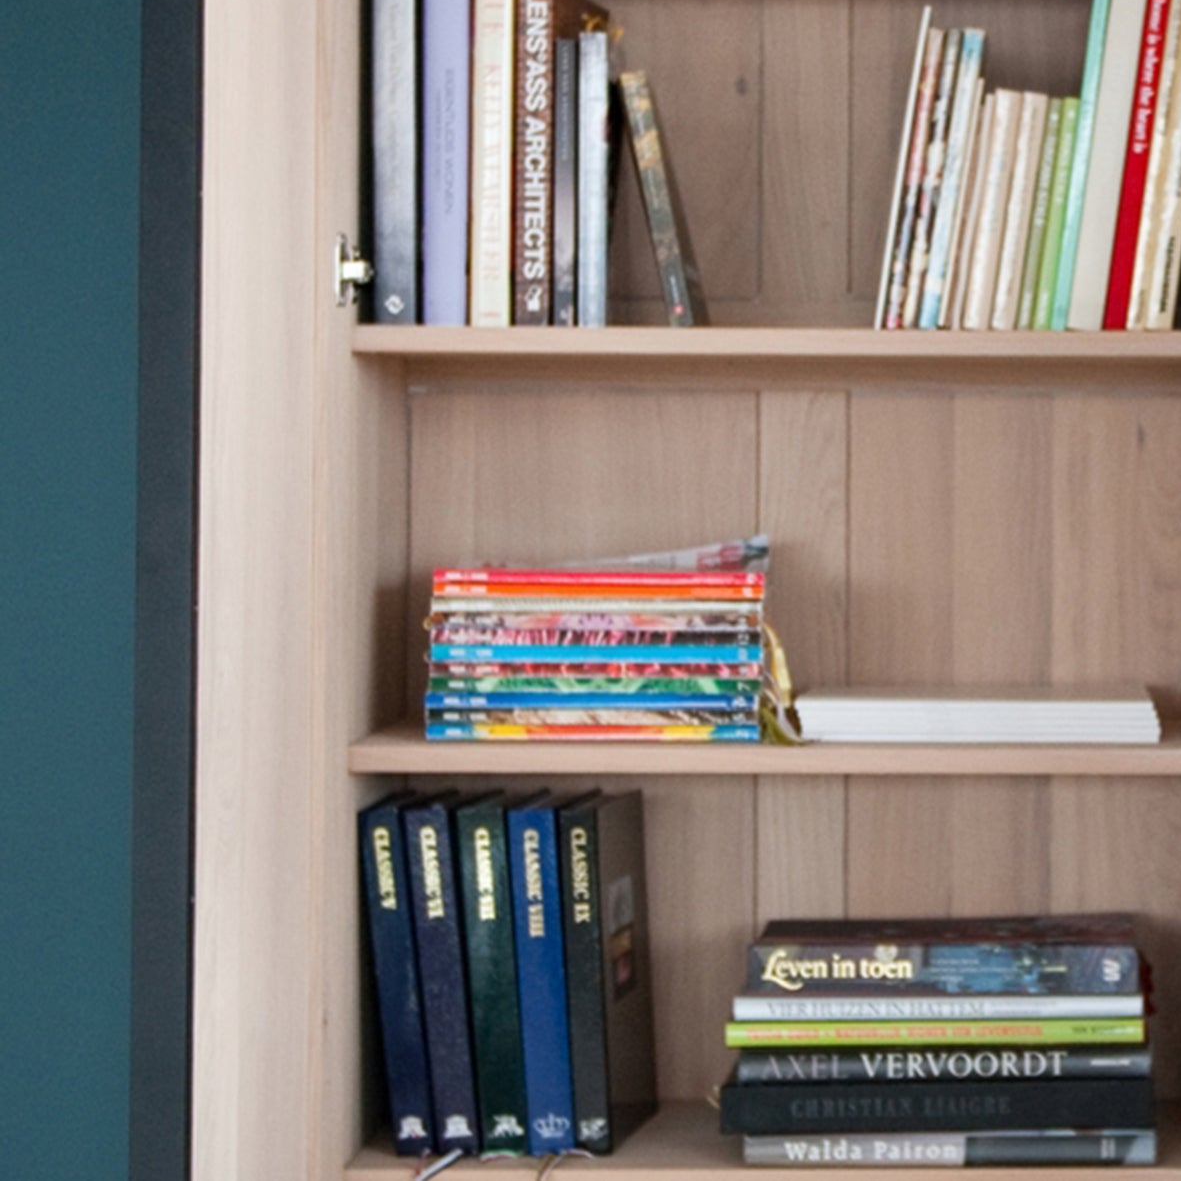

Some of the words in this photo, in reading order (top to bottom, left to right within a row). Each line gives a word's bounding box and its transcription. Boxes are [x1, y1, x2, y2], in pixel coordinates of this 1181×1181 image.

[1147, 33, 1160, 44] is
[1141, 47, 1159, 83] where
[483, 63, 504, 128] KELLY
[1139, 85, 1153, 104] the
[1134, 107, 1151, 139] heart
[1132, 142, 1146, 153] is
[443, 157, 454, 214] WONEN
[523, 116, 546, 278] ARCHITECTS
[481, 140, 503, 281] WEARSTLER
[372, 827, 395, 896] CLASSIC
[419, 825, 442, 896] CLASSIC
[474, 827, 493, 892] CLASSIC
[522, 828, 542, 900] CLASSIC
[570, 827, 589, 898] CLASSIC
[762, 950, 827, 990] Leven
[832, 956, 855, 979] in
[860, 959, 912, 979] toen
[761, 1057, 848, 1080] AXEL
[860, 1051, 1068, 1077] VERVOORDT
[791, 1099, 911, 1119] CHRISTIAN
[924, 1097, 1011, 1114] LIAIGRE
[785, 1142, 863, 1161] Walda
[874, 1142, 957, 1161] Pairon
